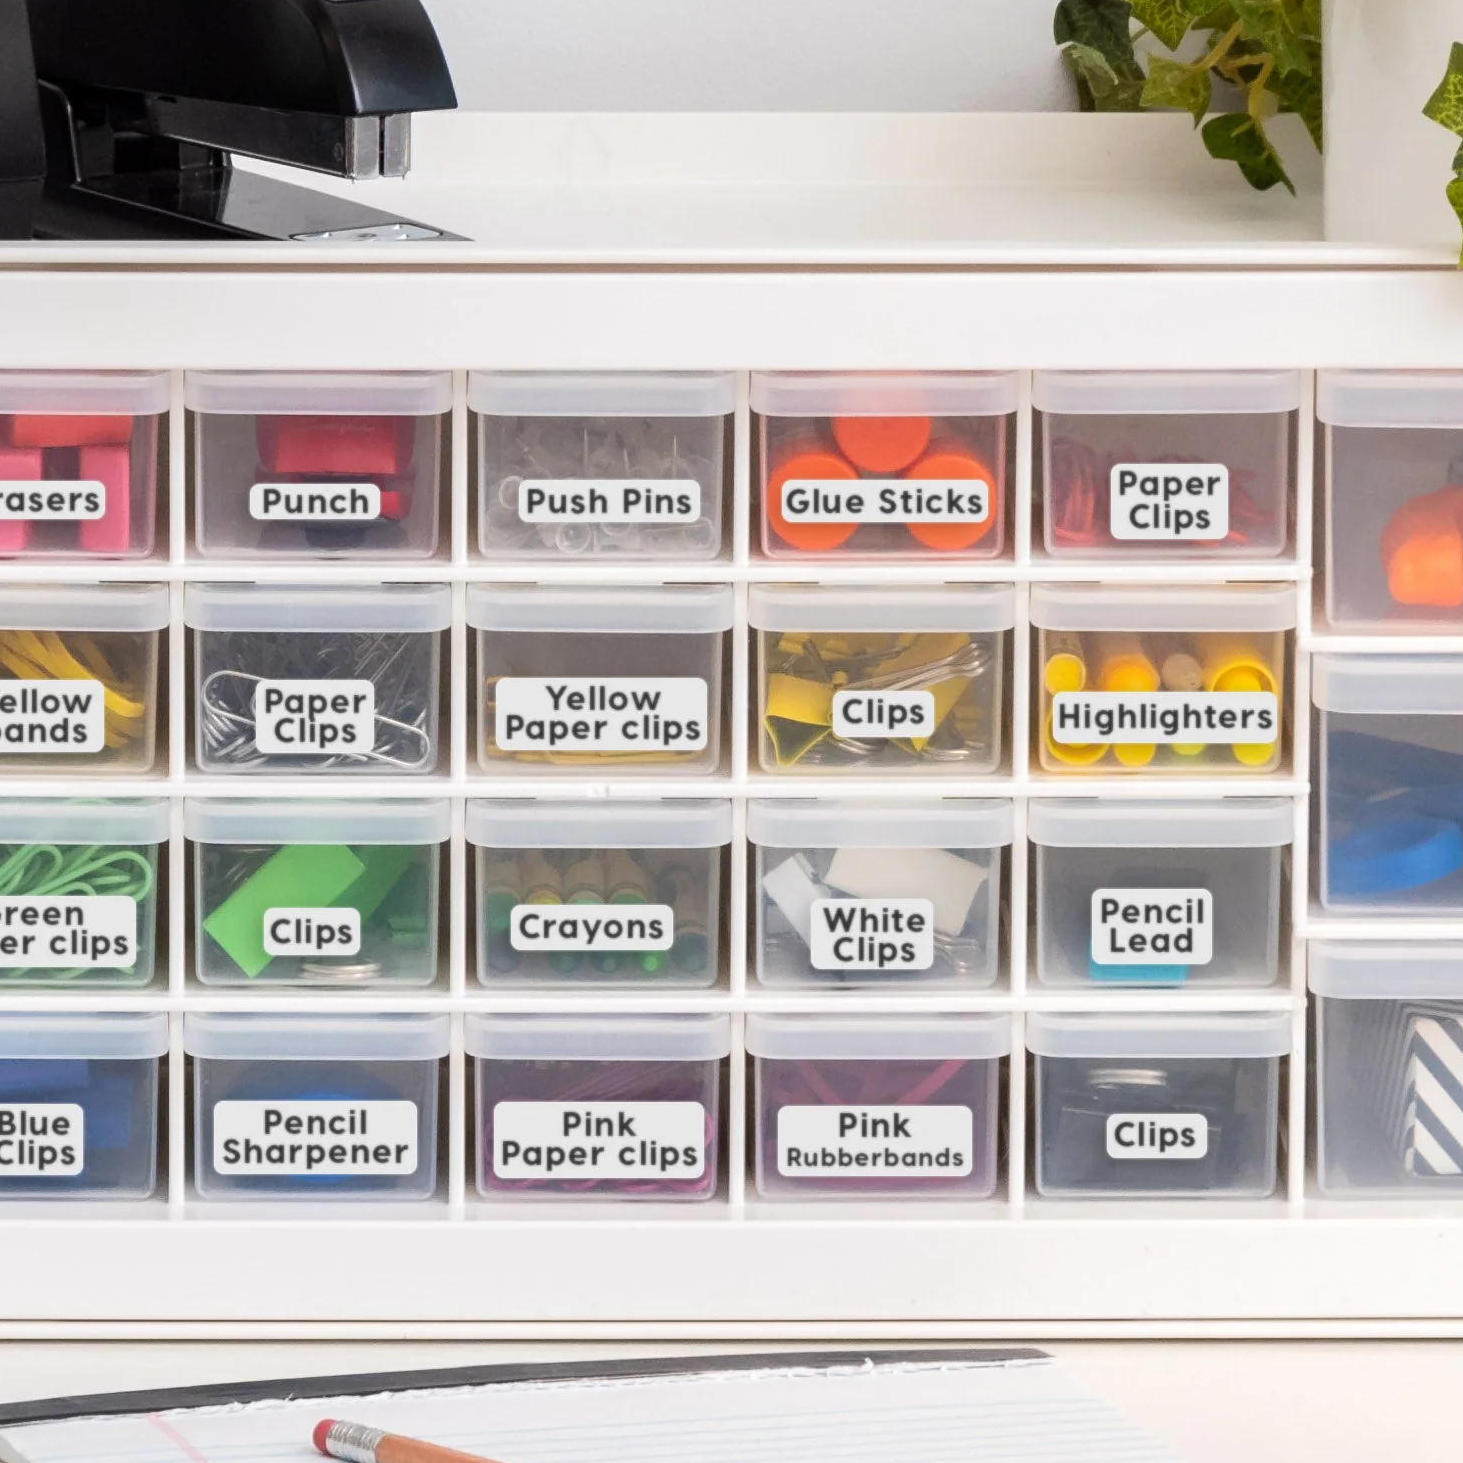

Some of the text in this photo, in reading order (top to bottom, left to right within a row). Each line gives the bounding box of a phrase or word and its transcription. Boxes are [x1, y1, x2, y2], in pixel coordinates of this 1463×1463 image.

[263, 488, 369, 514] Punch
[527, 488, 692, 515] Push Pins
[786, 488, 983, 515] Glue Sticks
[1119, 470, 1221, 502] Paper
[1129, 503, 1211, 535] Clips
[265, 688, 367, 720] Paper
[545, 685, 661, 711] Yellow
[842, 698, 925, 730] Clips
[274, 717, 357, 749] Clips
[506, 714, 701, 746] Paper clips
[1059, 703, 1273, 736] Highlighters
[822, 907, 926, 933] White
[1101, 898, 1204, 924] Pencil
[49, 929, 129, 961] clips
[270, 918, 353, 950] Clips
[519, 913, 664, 945] Crayons
[1110, 927, 1193, 953] Lead
[833, 936, 916, 967] Clips
[264, 1109, 367, 1135] Pencil
[563, 1111, 636, 1137] Pink
[839, 1112, 911, 1138] Pink
[1114, 1121, 1196, 1153] Clips
[223, 1138, 409, 1170] Sharpener
[502, 1140, 698, 1172] Paper clips
[787, 1147, 964, 1167] Rubberbands
